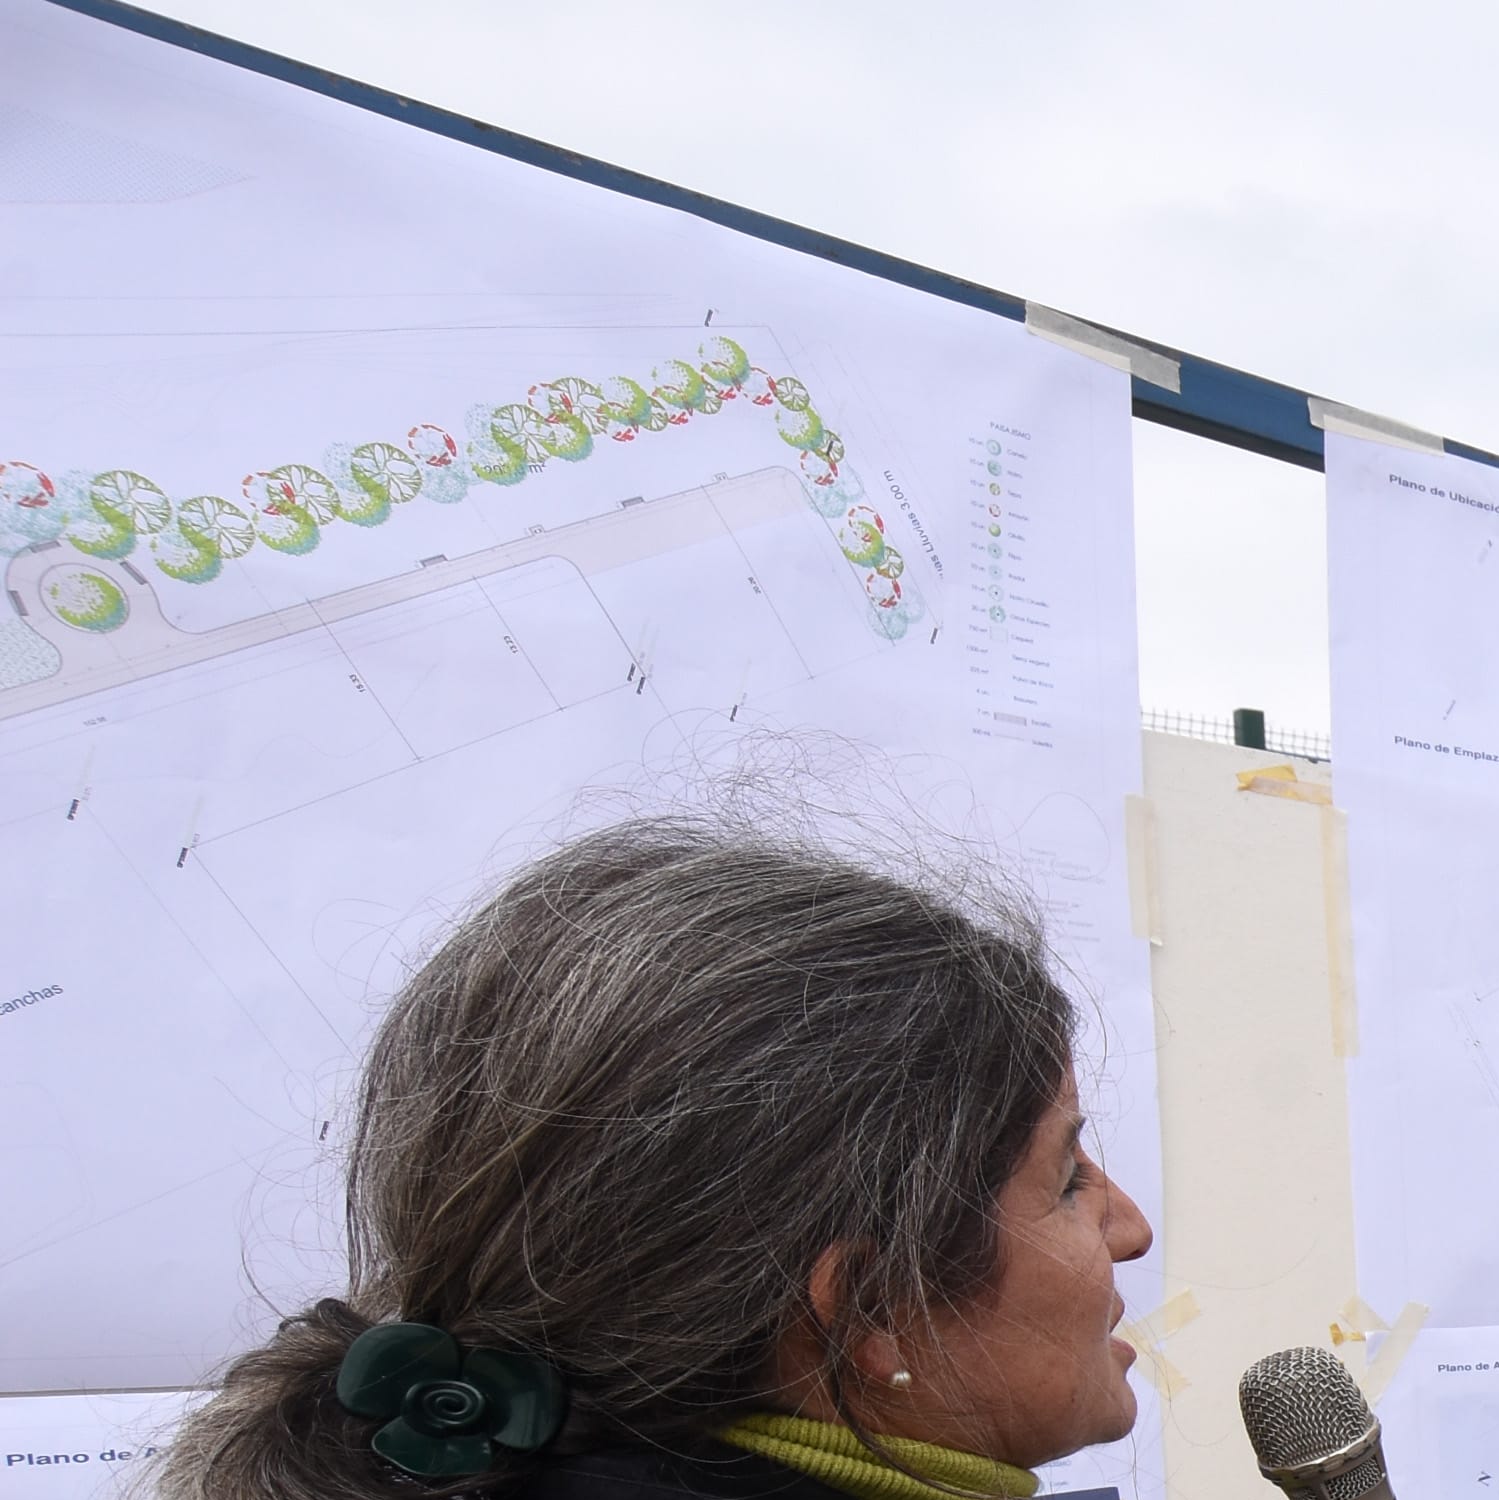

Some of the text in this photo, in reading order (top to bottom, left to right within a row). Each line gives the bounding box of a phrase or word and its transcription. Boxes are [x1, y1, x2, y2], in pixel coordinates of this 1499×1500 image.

[1389, 474, 1426, 492] Plano
[1430, 486, 1445, 498] de
[1394, 735, 1431, 750] Plano
[1434, 743, 1450, 754] de
[1437, 1363, 1472, 1373] Plano
[1475, 1362, 1490, 1371] de
[6, 1452, 90, 1467] Plano
[99, 1449, 132, 1462] de
